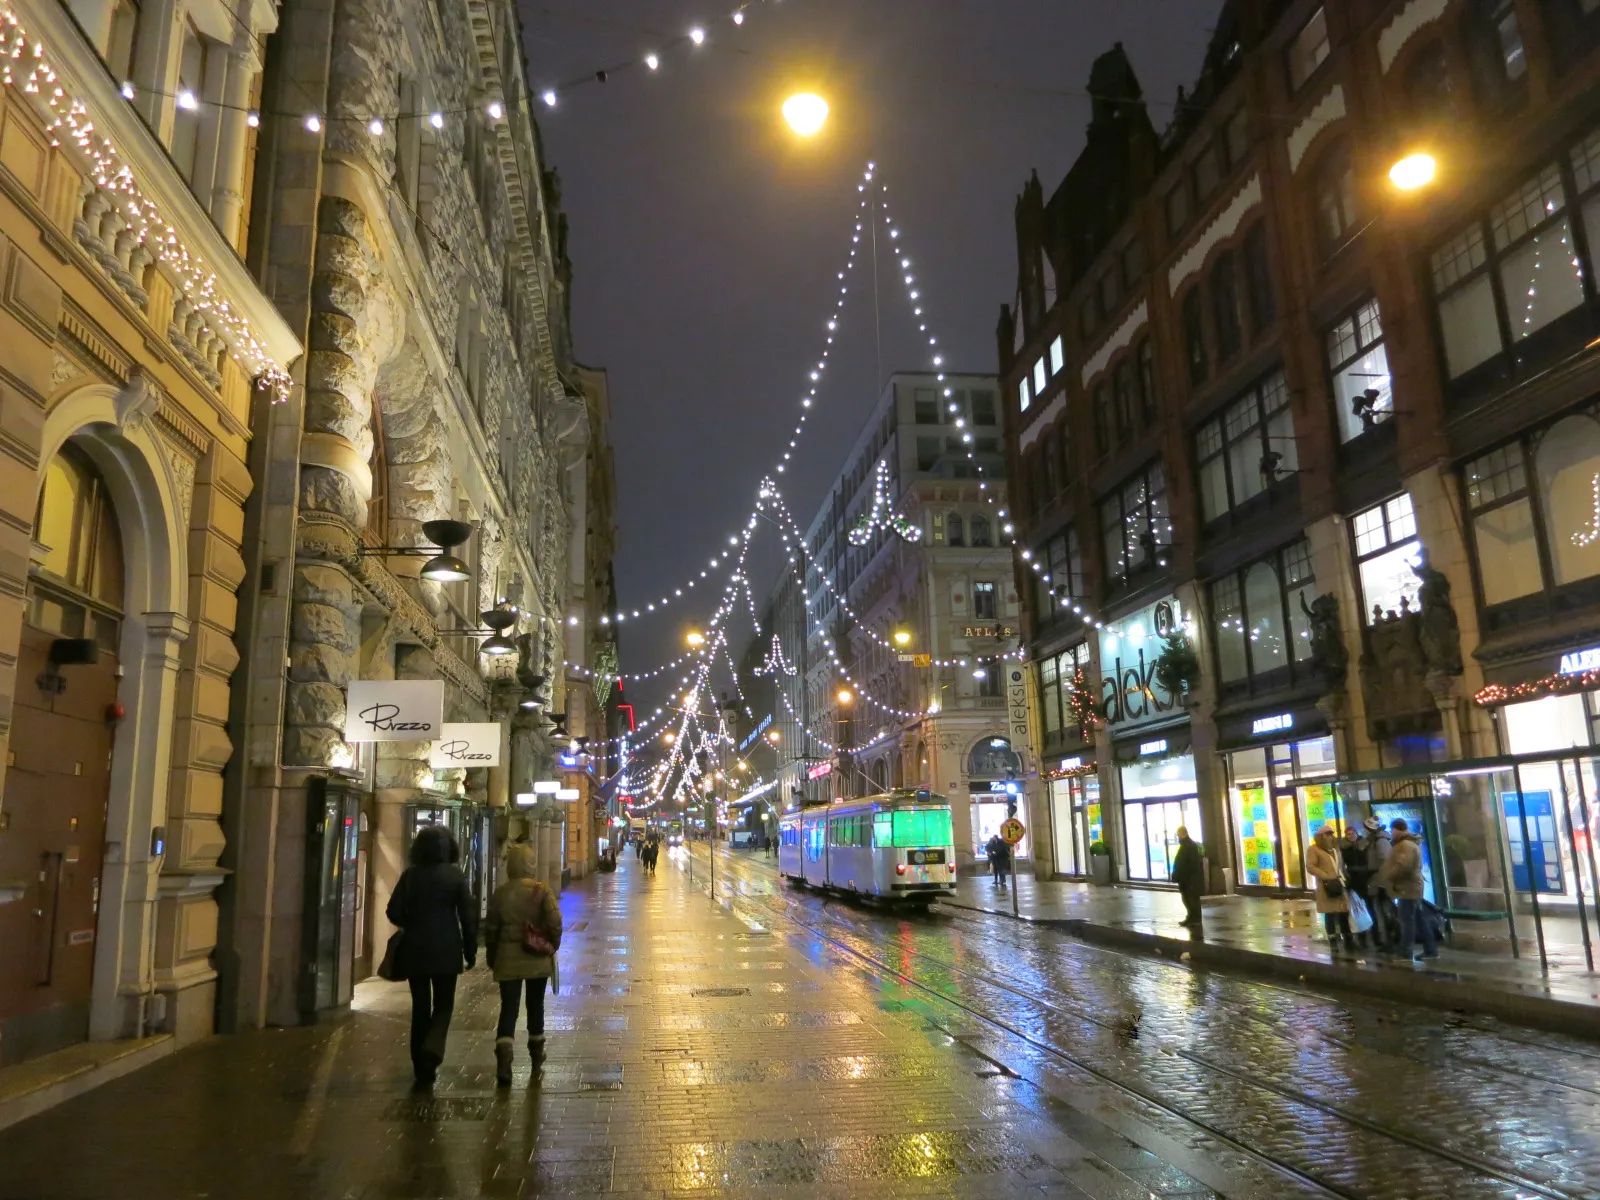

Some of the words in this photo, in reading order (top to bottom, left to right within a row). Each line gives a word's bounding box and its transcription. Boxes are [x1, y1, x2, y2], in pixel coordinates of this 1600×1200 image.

[358, 703, 432, 732] Rizzo
[1009, 684, 1027, 735] aleksi
[440, 740, 492, 760] Rizzo
